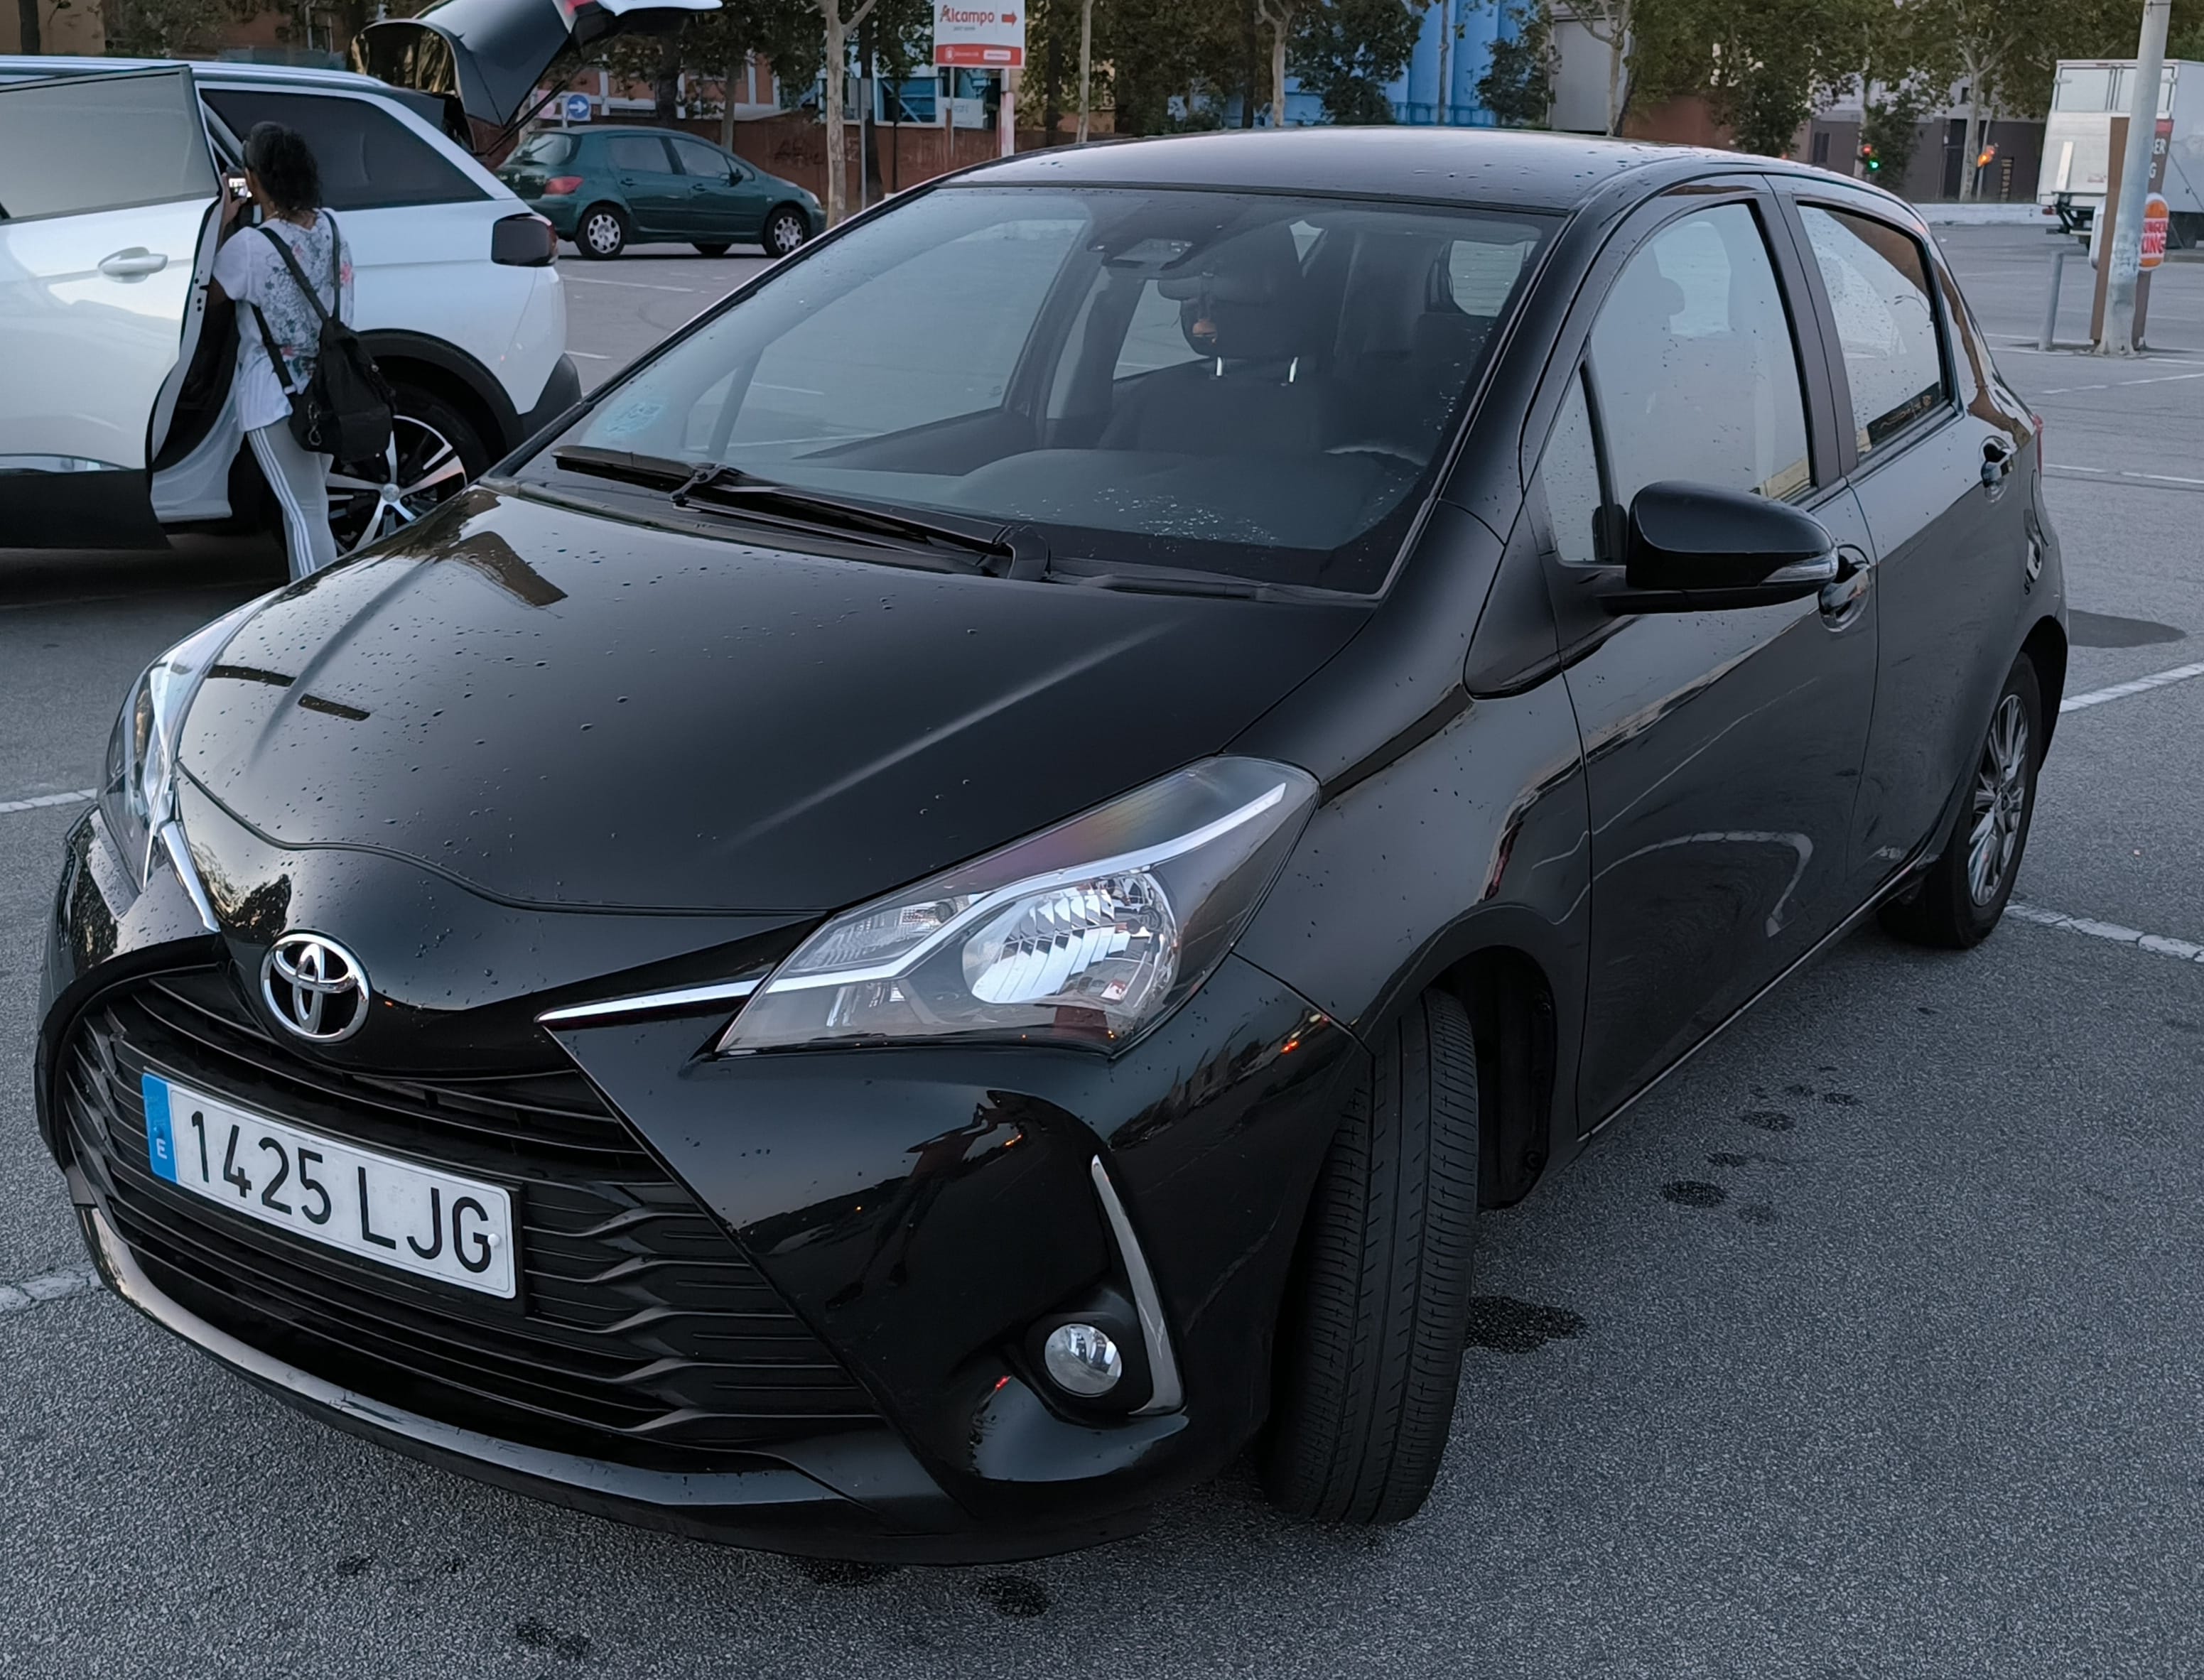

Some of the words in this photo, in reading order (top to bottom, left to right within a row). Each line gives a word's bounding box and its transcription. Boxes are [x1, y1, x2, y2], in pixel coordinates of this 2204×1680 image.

[940, 4, 995, 26] Alcampo
[156, 1138, 168, 1160] E
[190, 1110, 332, 1225] 1425
[357, 1166, 492, 1274] LJG
